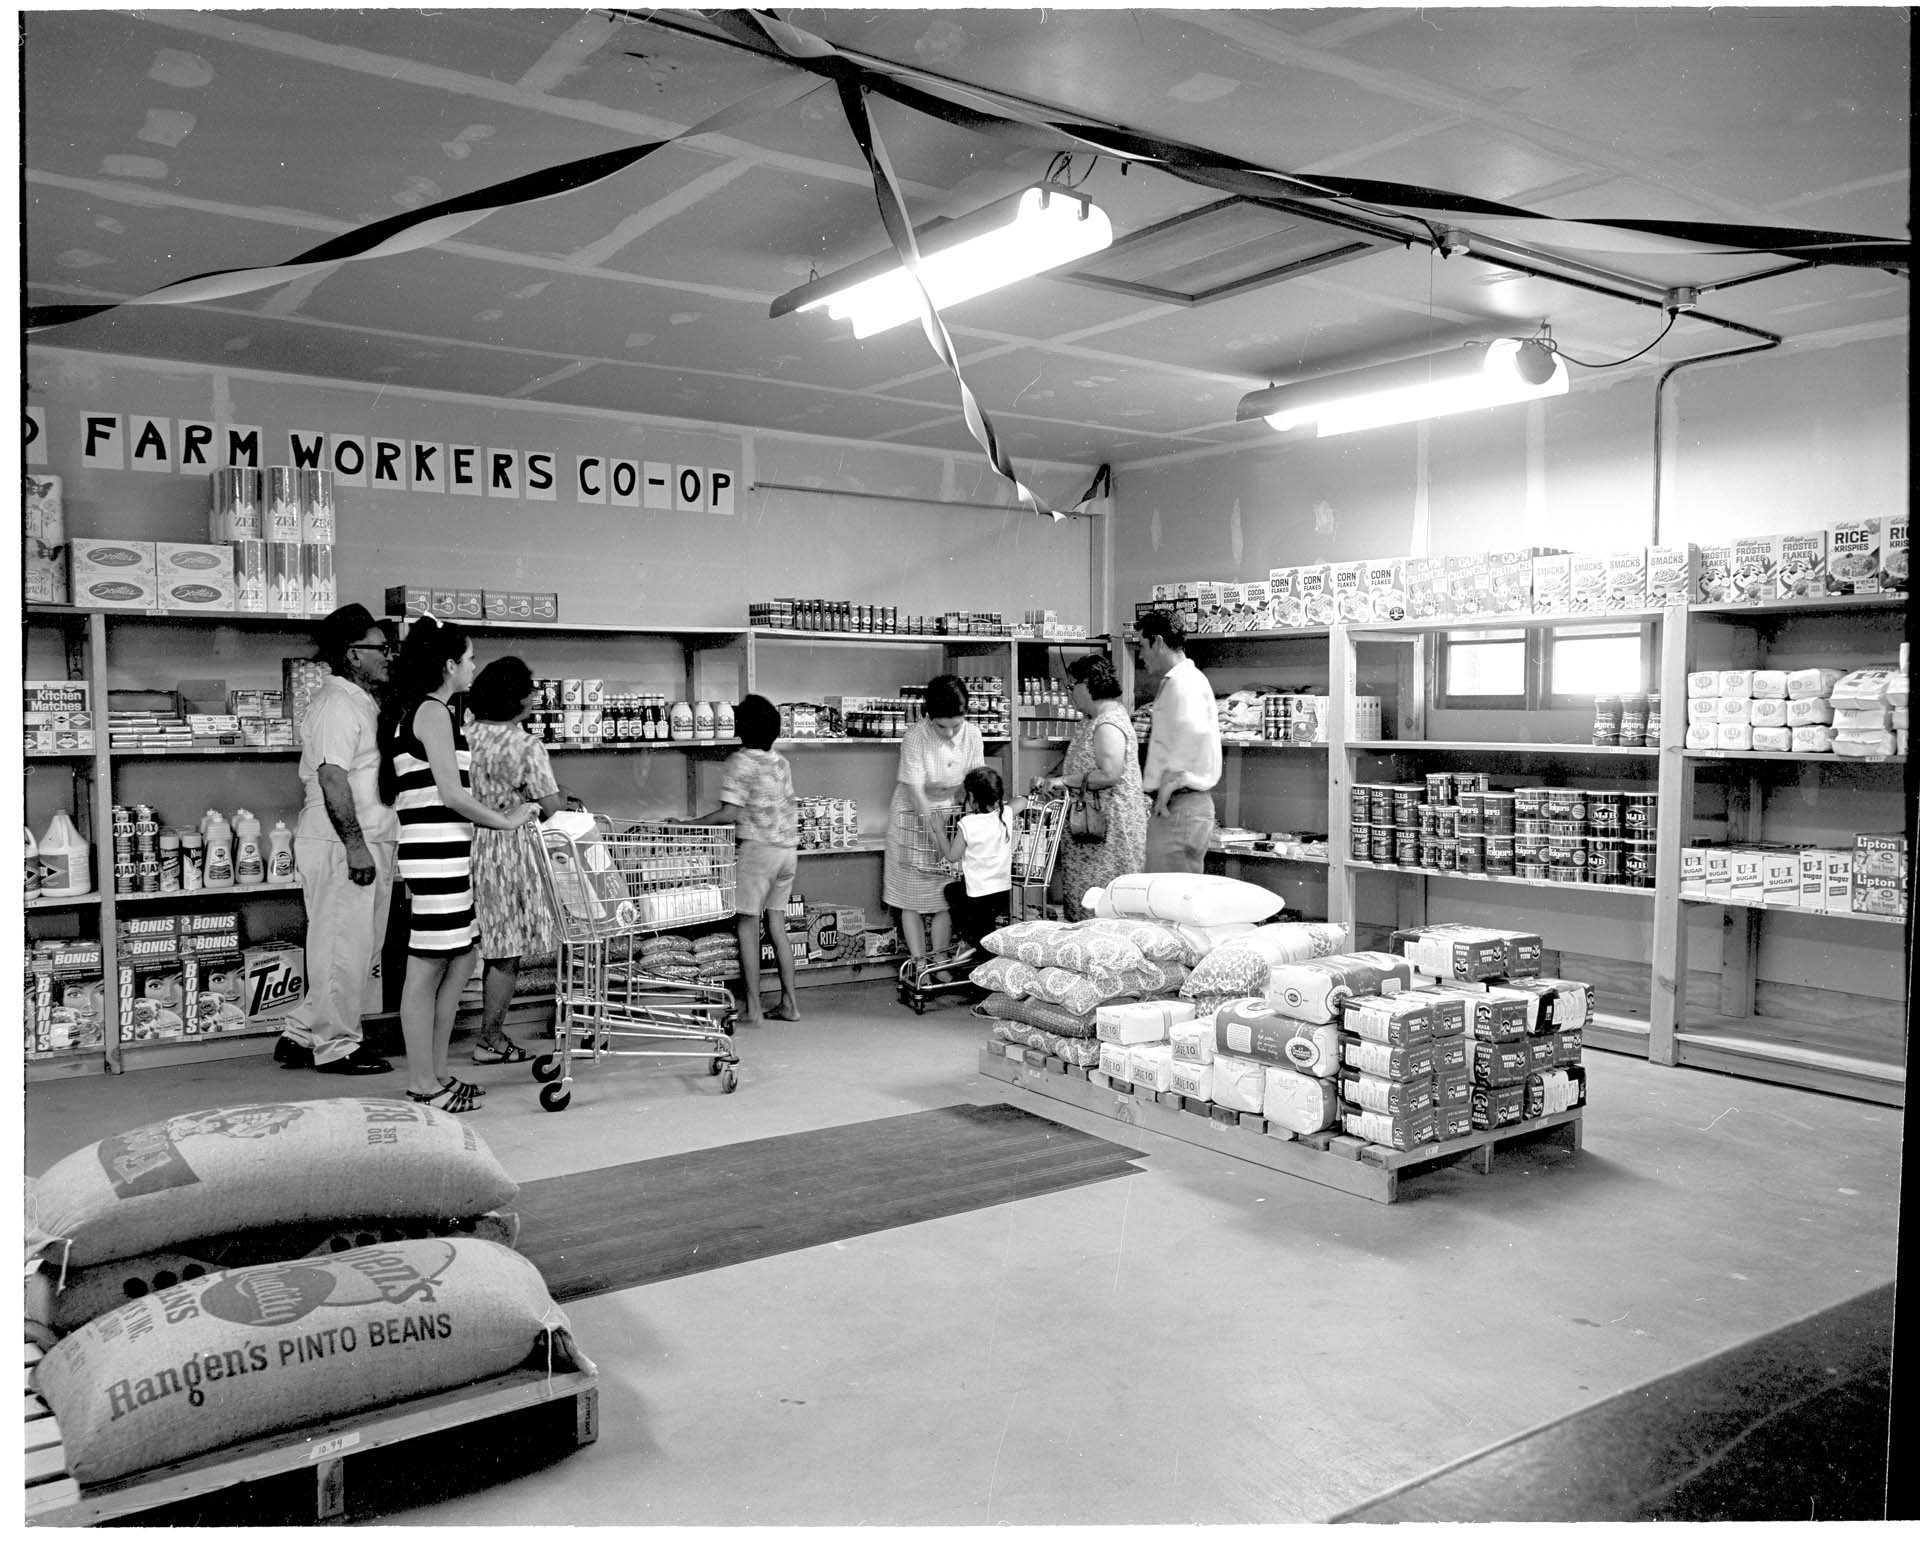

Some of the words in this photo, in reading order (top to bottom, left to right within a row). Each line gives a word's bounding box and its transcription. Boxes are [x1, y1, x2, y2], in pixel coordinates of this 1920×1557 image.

[85, 417, 259, 466] FARM
[290, 434, 553, 489] WORKERS
[578, 458, 731, 506] CO-OP
[1835, 530, 1869, 544] RICE
[1889, 538, 1909, 548] KRIS
[1736, 546, 1771, 555] FROSTED
[1782, 541, 1818, 551] FROSTED
[1834, 543, 1869, 552] KRISPIES
[1651, 555, 1684, 566] SMACKS
[1736, 555, 1765, 564] FLAKES
[1782, 550, 1811, 560] FLAKES
[1609, 559, 1641, 568] SMACKS
[1701, 559, 1728, 568] FLAKES
[1303, 575, 1322, 585] CORN
[1337, 572, 1356, 582] CORN
[1371, 569, 1391, 580] CORN
[1271, 578, 1289, 588] CORN
[37, 690, 82, 701] Kitchen
[31, 701, 82, 711] Matches
[1593, 811, 1618, 819] MJB
[1626, 812, 1646, 821] MJB
[114, 823, 133, 836] AJAX
[136, 822, 157, 835] AJAX
[1857, 836, 1896, 850] Lipton
[1588, 857, 1607, 865] MJB
[1626, 860, 1646, 869] MJB
[115, 864, 136, 877] AJAX
[140, 862, 159, 875] AJAX
[1857, 874, 1896, 887] Lipton
[130, 919, 175, 933] BONUS
[193, 916, 236, 930] BONUS
[196, 936, 238, 950] BONUS
[820, 930, 837, 946] RITZ
[133, 940, 176, 954] BONUS
[54, 952, 99, 965] BONUS
[249, 963, 302, 1017] Tide
[120, 969, 133, 1040] BONUS
[185, 963, 198, 1034] BONUS
[36, 977, 51, 1051] BONUS
[367, 1127, 382, 1145] 100
[383, 1126, 398, 1144] LBS.
[105, 1341, 268, 1421] Rangen's
[279, 1326, 357, 1366] PINTO
[368, 1313, 452, 1347] BEANS
